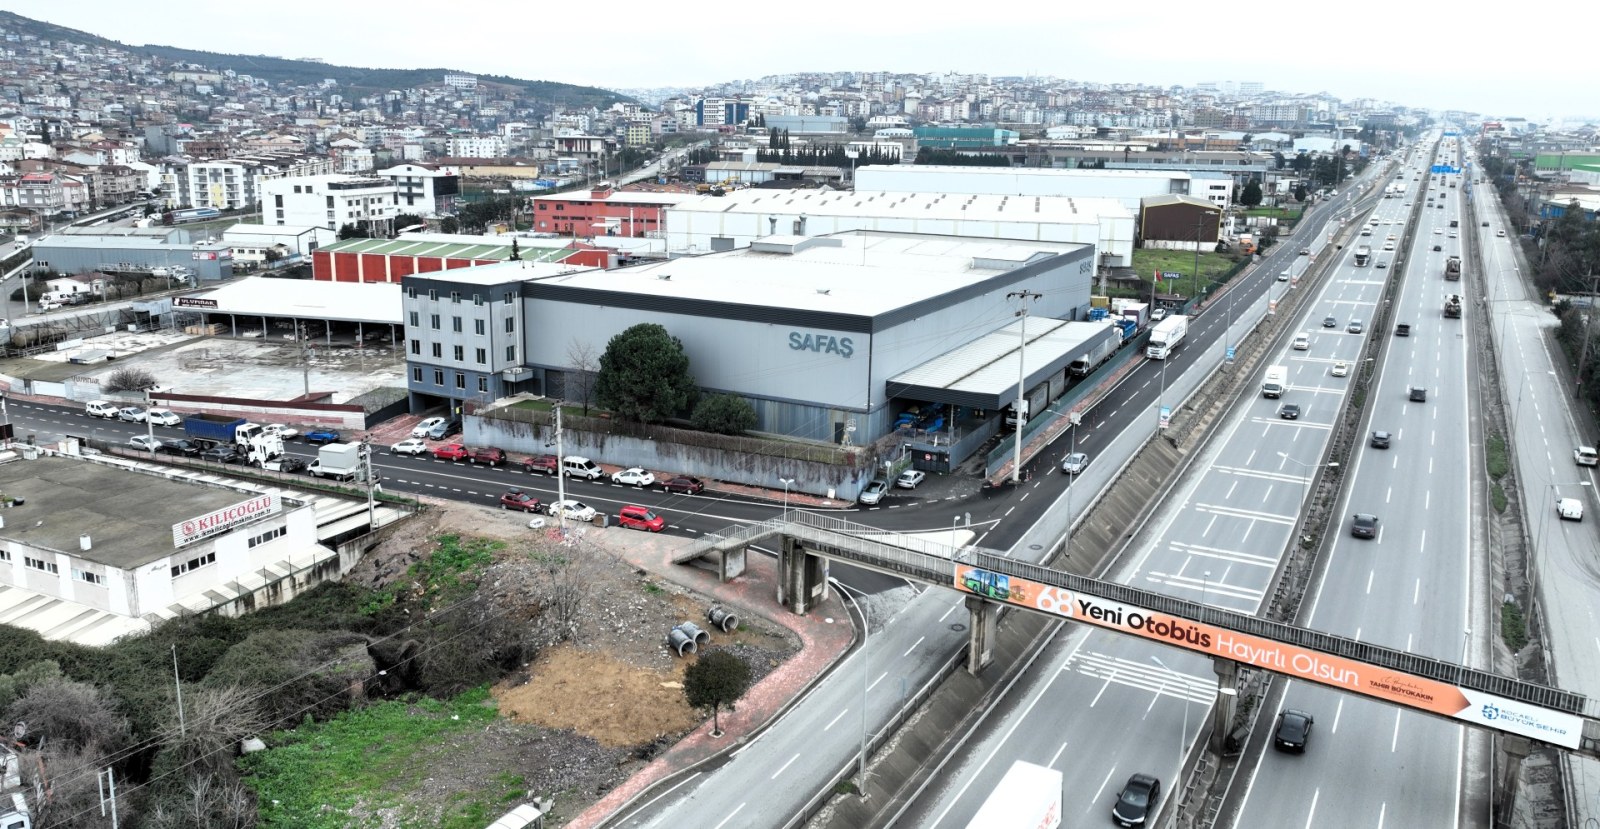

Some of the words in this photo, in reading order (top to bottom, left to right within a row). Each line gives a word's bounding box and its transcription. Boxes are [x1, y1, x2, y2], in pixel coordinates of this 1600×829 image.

[789, 331, 854, 359] SAFAŞ
[199, 497, 271, 530] KILIÇOĞLU
[1036, 585, 1075, 618] 68
[1077, 599, 1123, 625] Yeni
[1127, 612, 1211, 648] Otobüs
[1216, 633, 1286, 669] Hayırlı
[1292, 653, 1360, 687] Olsun
